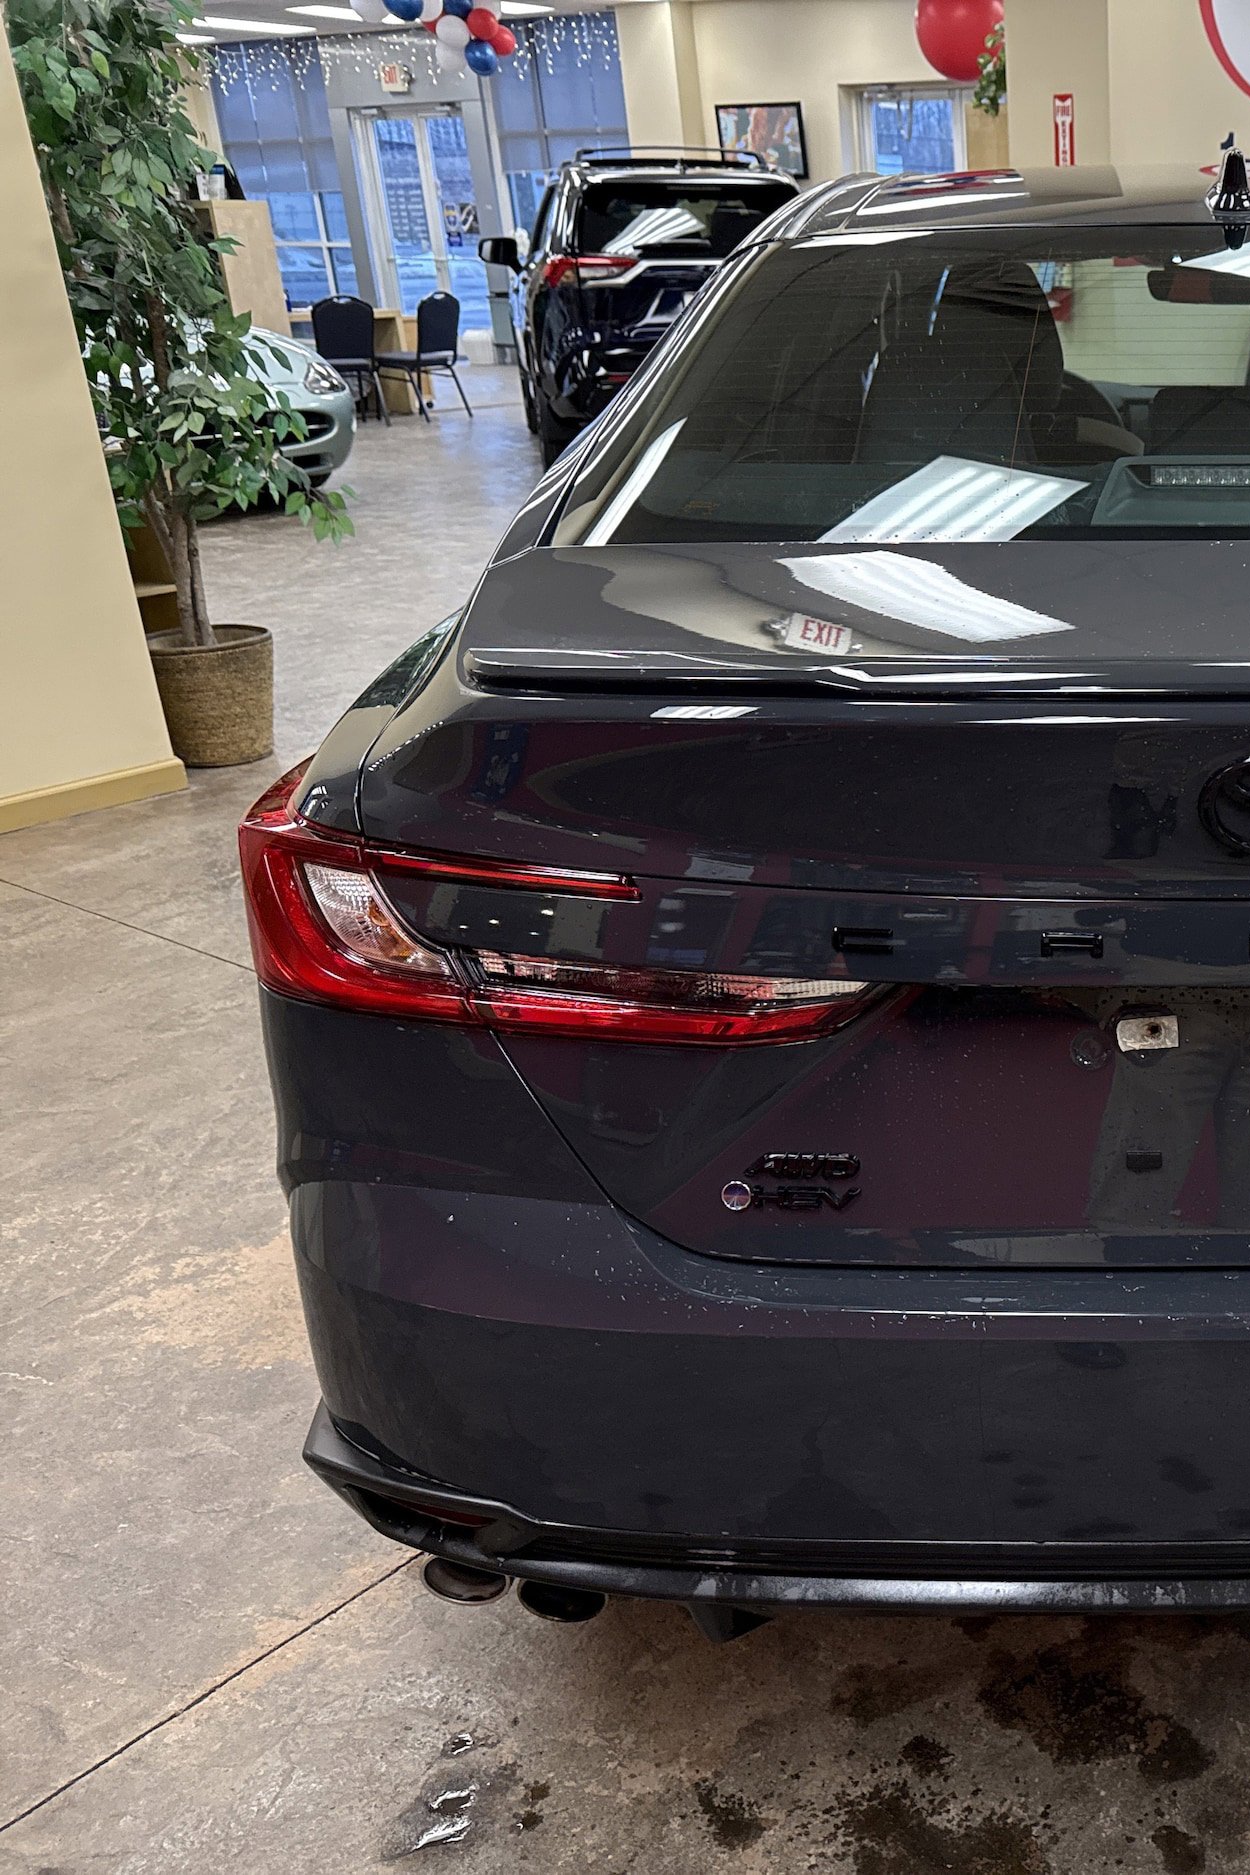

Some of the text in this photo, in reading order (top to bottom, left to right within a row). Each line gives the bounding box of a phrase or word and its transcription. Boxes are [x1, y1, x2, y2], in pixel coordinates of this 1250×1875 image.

[800, 619, 846, 648] EXIT
[743, 1152, 861, 1179] AWD
[751, 1185, 862, 1210] HEV
